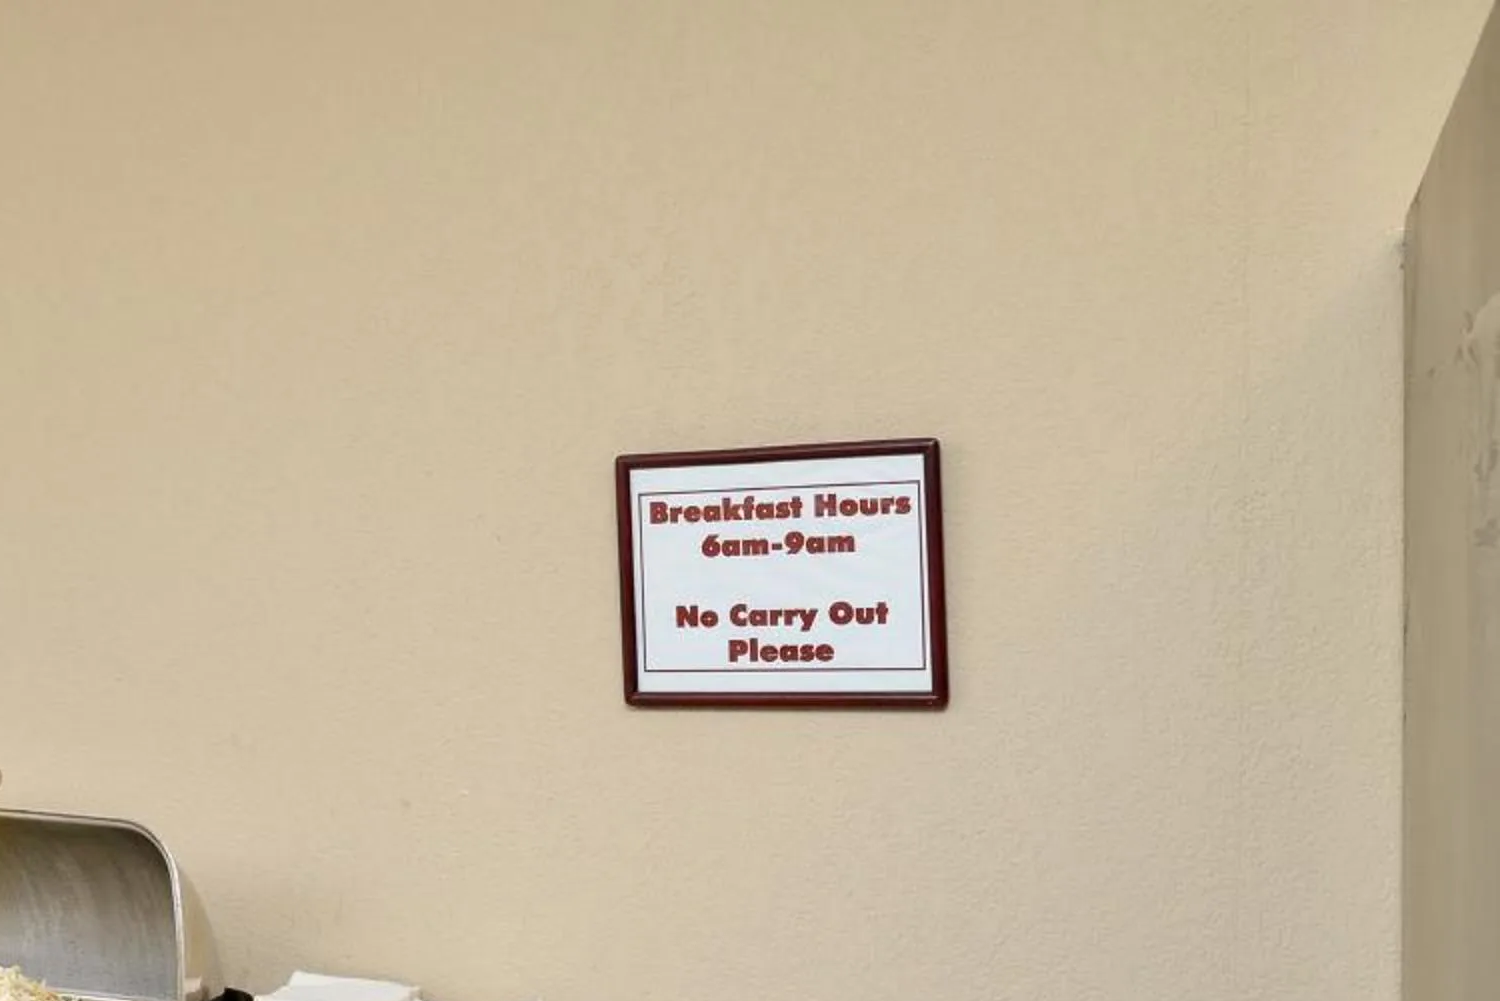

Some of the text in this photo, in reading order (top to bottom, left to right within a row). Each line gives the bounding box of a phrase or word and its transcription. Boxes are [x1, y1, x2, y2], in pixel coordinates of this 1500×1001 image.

[649, 493, 912, 524] Breakfast Hours
[701, 530, 856, 558] 6am-9am
[675, 601, 889, 632] No Carry Out
[728, 638, 835, 663] Please
